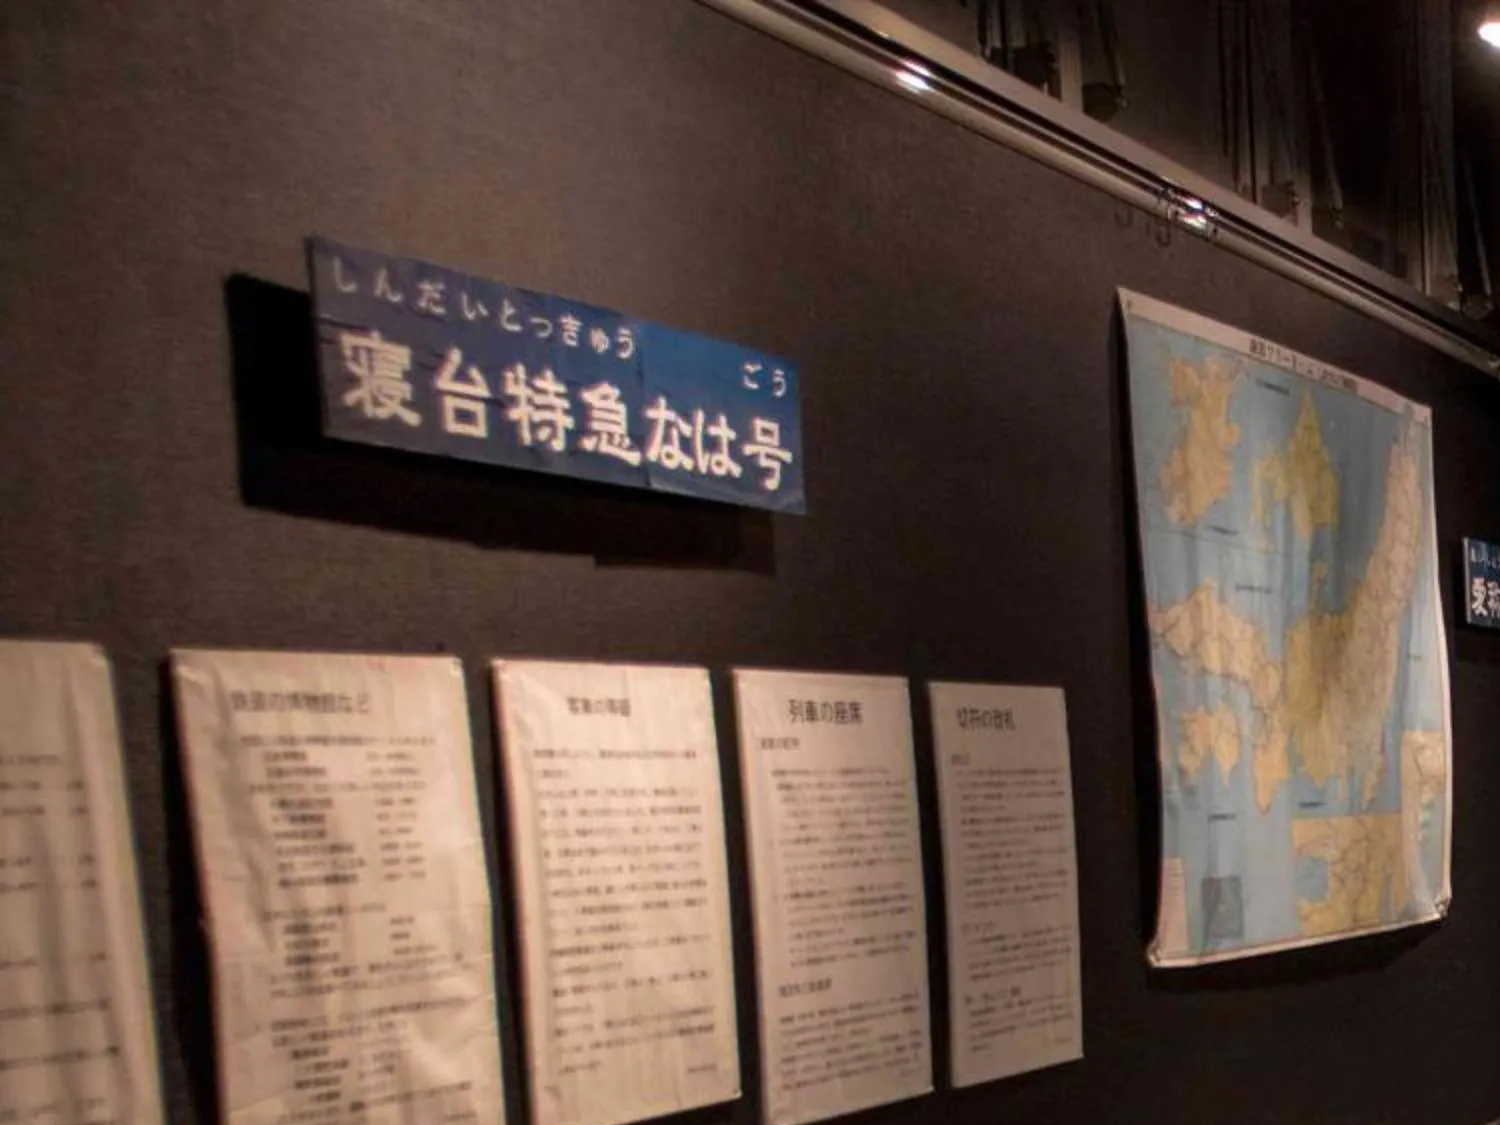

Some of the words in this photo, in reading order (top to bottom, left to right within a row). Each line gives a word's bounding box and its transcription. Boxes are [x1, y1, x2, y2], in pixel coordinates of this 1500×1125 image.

[332, 256, 636, 361] しんだいとっきゅう
[740, 362, 787, 398] ごう
[337, 326, 794, 492] 寝台特急なは号
[788, 699, 863, 724] 列車の座席
